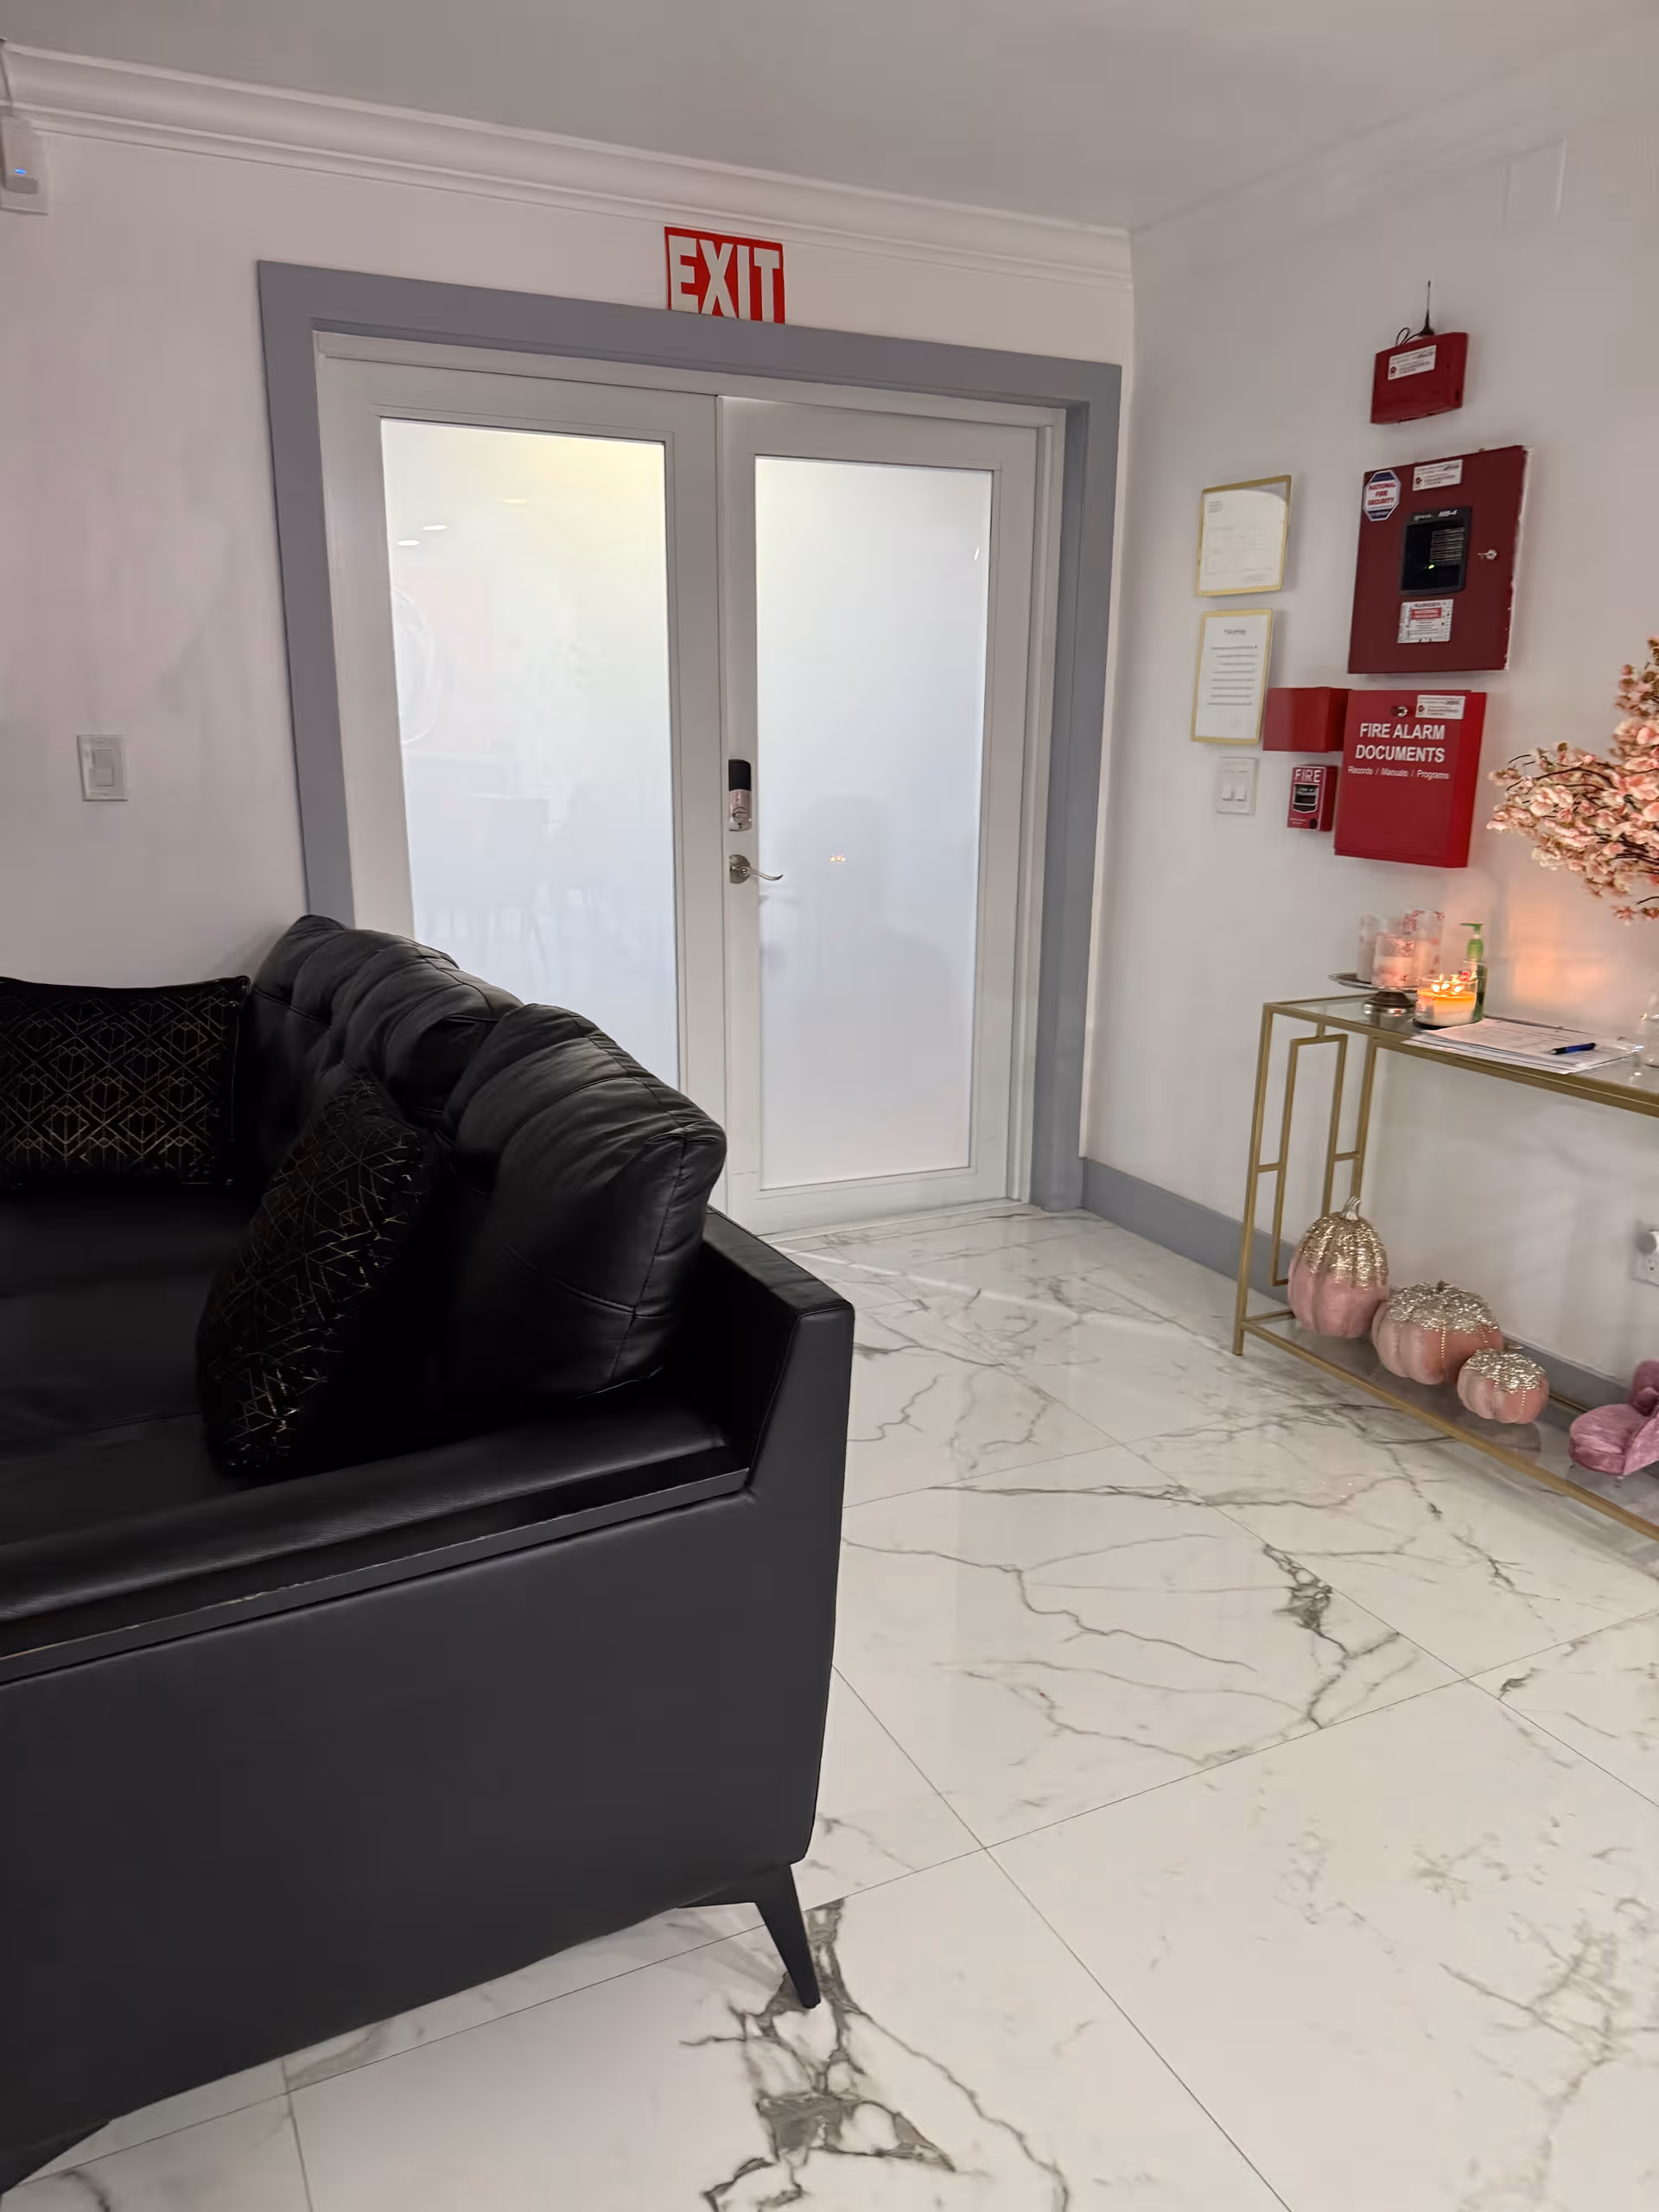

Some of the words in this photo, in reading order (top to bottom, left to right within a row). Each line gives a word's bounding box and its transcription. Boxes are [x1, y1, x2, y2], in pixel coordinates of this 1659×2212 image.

[668, 235, 780, 323] EXIT
[1359, 722, 1391, 739] FIRE
[1392, 723, 1446, 741] ALARM
[1355, 744, 1446, 763] DOCUMENTS
[1295, 768, 1323, 783] FIRE
[1347, 766, 1374, 775] Records
[1381, 767, 1408, 777] Manuals
[1416, 769, 1451, 781] Programs
